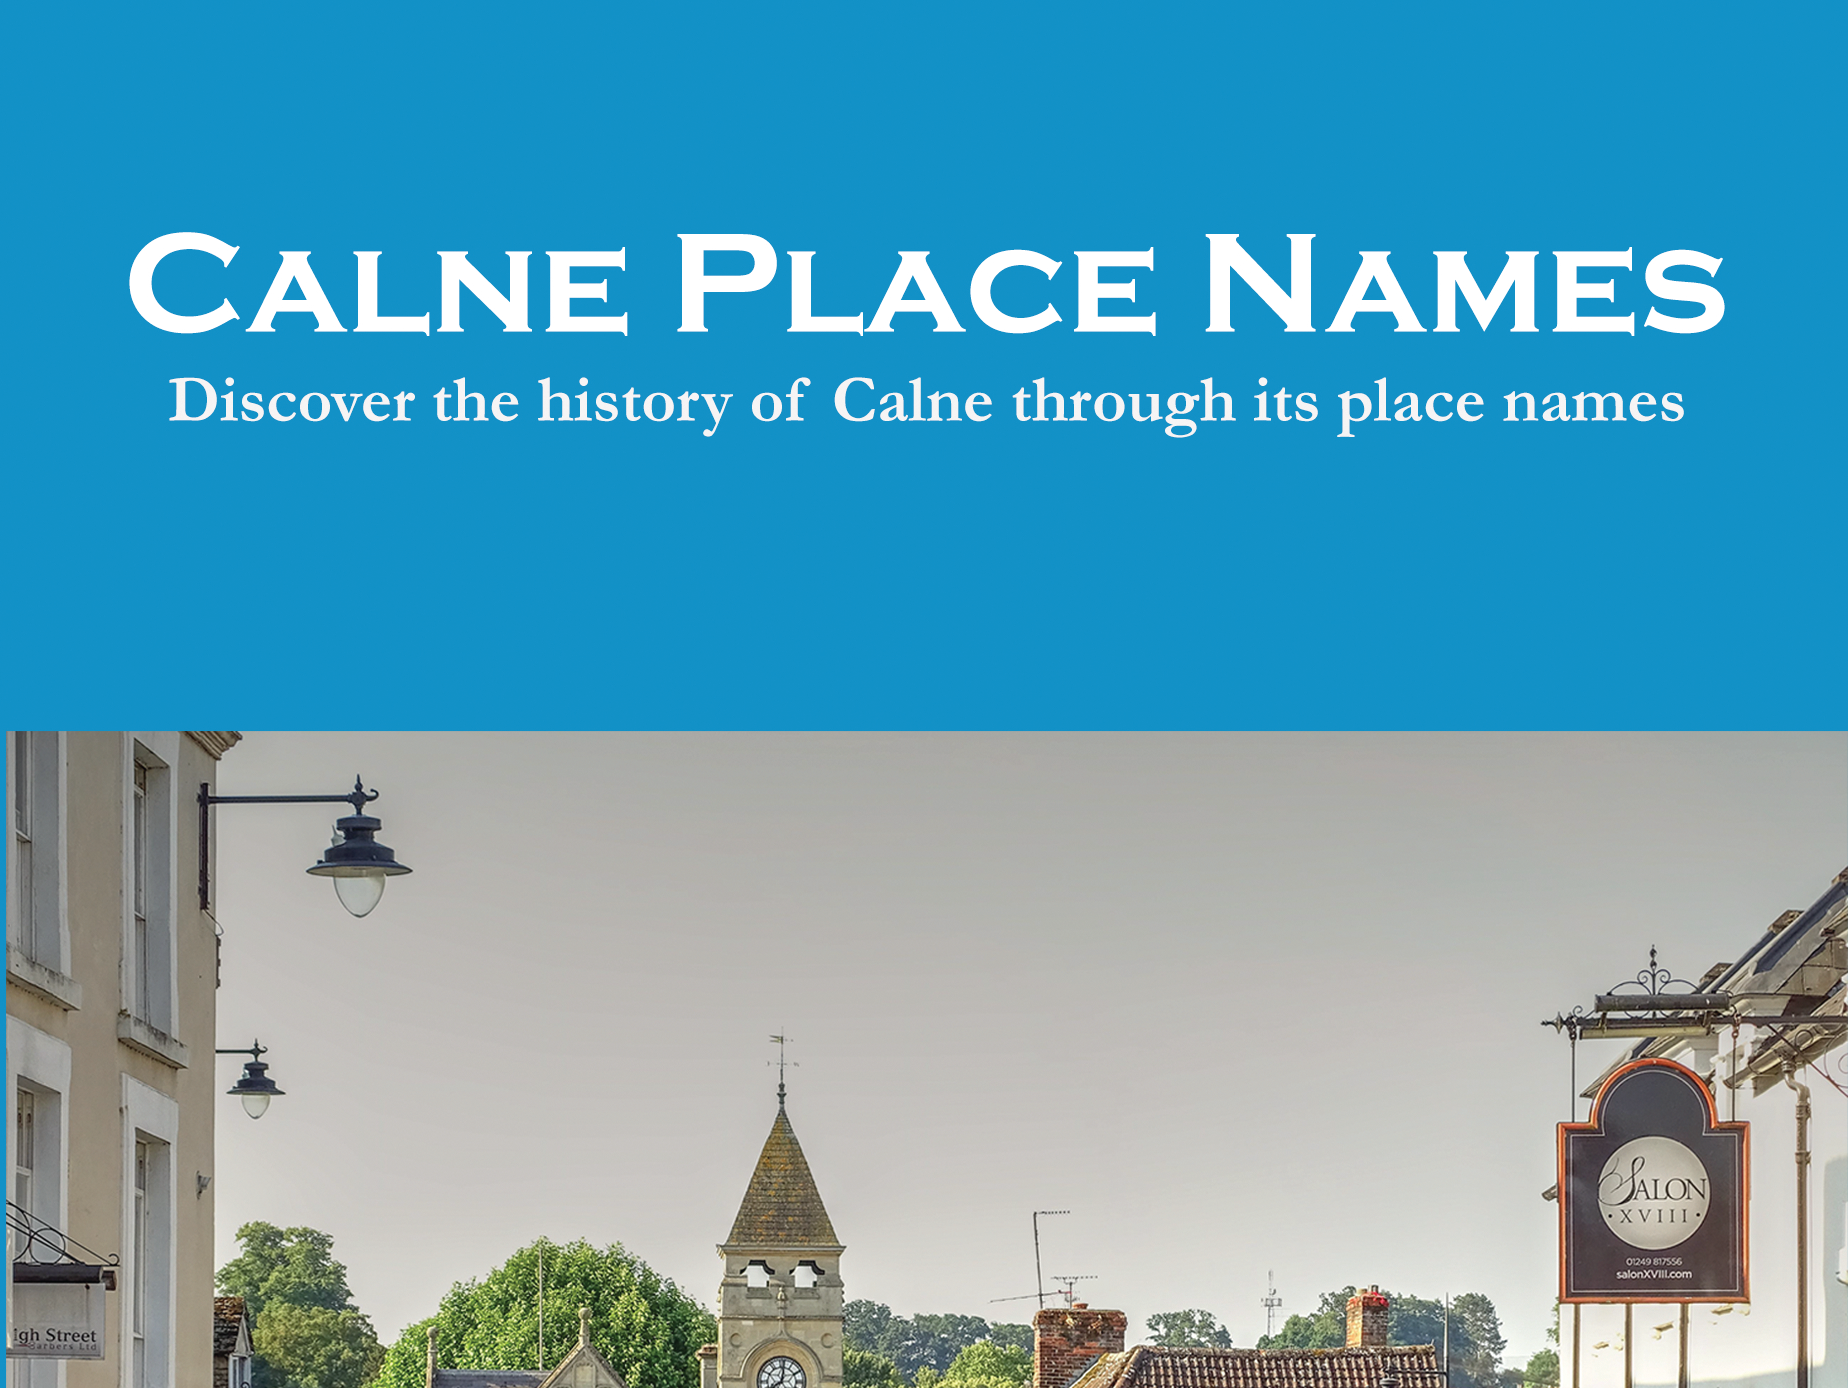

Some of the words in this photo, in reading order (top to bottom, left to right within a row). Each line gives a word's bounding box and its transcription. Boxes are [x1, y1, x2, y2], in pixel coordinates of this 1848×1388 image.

[1620, 1209, 1687, 1223] XVIII
[1626, 1258, 1651, 1266] 01249
[1653, 1258, 1682, 1266] 817556
[1616, 1269, 1692, 1280] salonXVIII.com
[13, 1328, 40, 1344] igh
[45, 1328, 97, 1342] Street
[79, 1342, 97, 1350] Ltd
